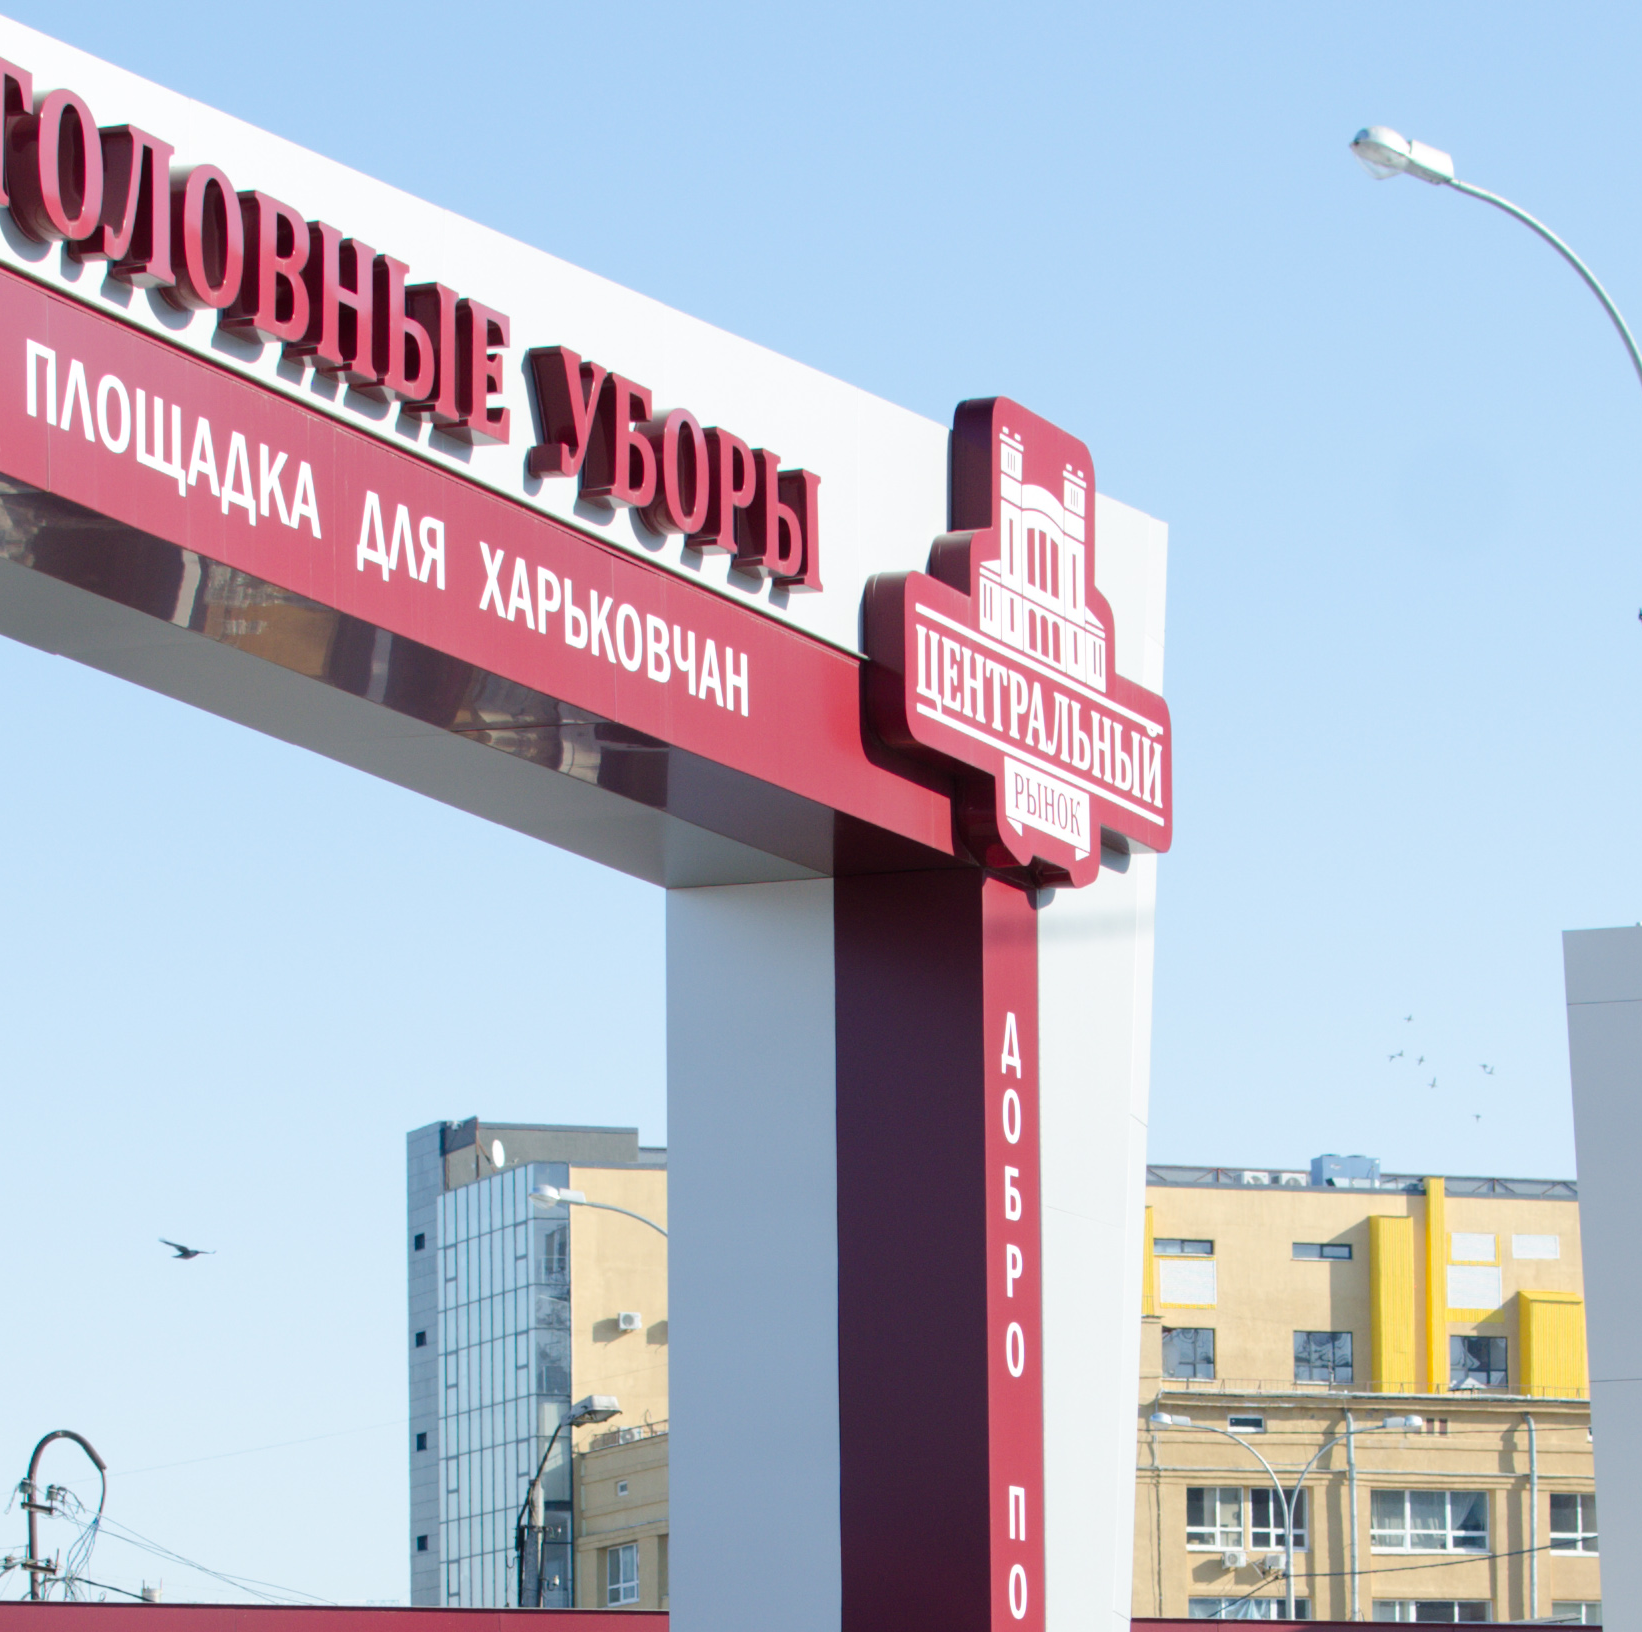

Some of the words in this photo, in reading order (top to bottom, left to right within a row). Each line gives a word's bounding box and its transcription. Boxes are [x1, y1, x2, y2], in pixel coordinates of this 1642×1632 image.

[26, 339, 321, 539] ПЛОЩАДКА
[358, 490, 445, 590] ДЛЯ
[479, 541, 749, 717] ХАРЬКОВЧАН
[530, 345, 823, 593] УБОРЫ
[917, 620, 1163, 809] ЦЕНТРАЛЬНЫЙ
[1013, 780, 1082, 837] РЫНОК
[1001, 1012, 1025, 1377] ДОБРО
